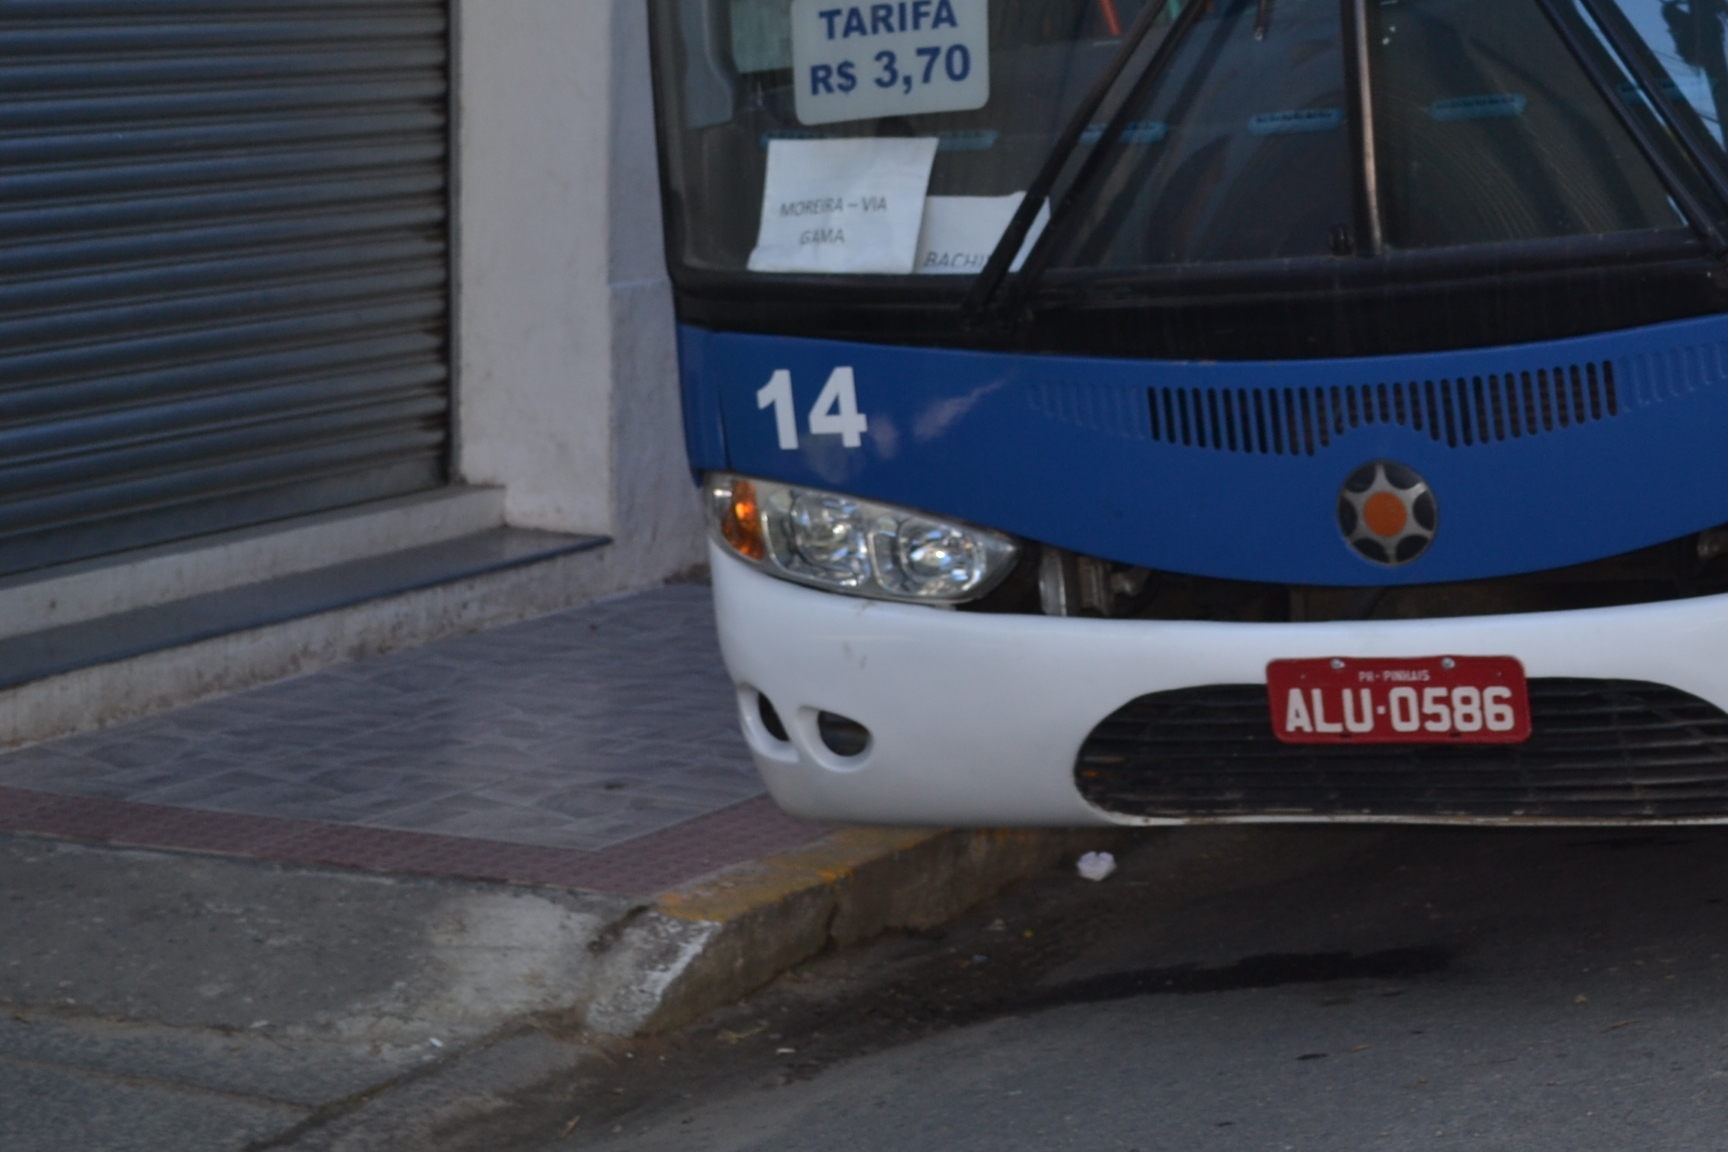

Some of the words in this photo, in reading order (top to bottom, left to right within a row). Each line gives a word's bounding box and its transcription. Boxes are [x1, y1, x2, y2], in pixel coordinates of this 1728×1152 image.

[810, 60, 857, 96] R$
[873, 44, 972, 95] 3,70
[780, 197, 844, 218] MOREIRA
[862, 196, 887, 213] VIA
[800, 228, 845, 246] GAMA
[923, 251, 988, 268] BACHI
[757, 366, 868, 450] 14
